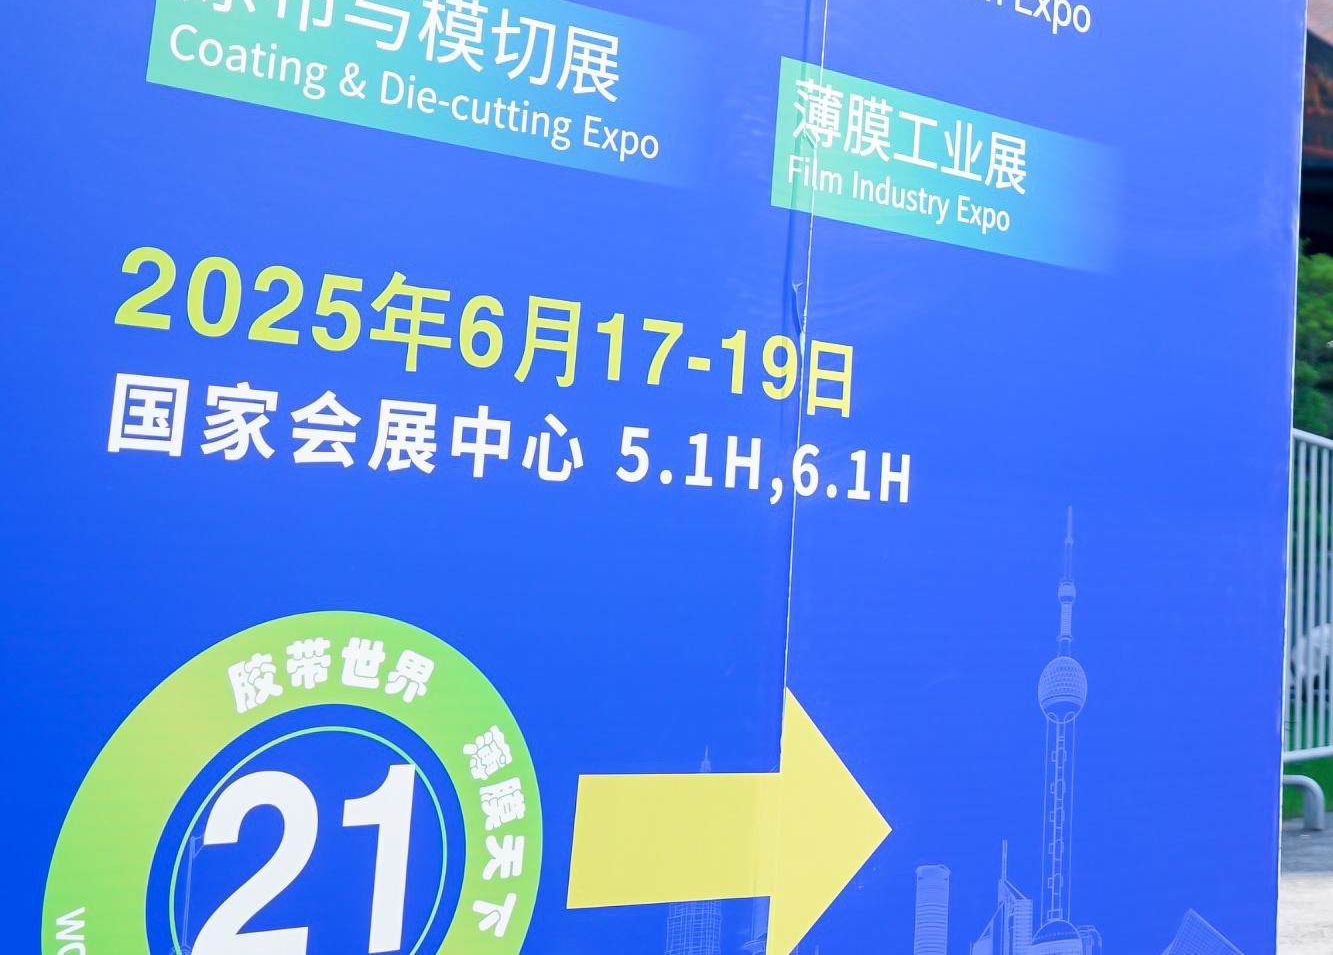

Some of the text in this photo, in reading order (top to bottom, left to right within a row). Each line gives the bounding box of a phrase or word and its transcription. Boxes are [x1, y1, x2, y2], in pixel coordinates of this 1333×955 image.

[170, 24, 660, 162] Coating & Die-cutting Expo
[792, 78, 1027, 195] 薄膜工业展
[788, 155, 1010, 234] Film Industry Expo
[115, 247, 853, 418] 2025年6月17-19日
[108, 373, 911, 504] 国家会展中心 5.1H,6.1H
[227, 637, 434, 713] 胶带世界
[191, 764, 415, 955] 21
[463, 725, 525, 937] 薄膜天下
